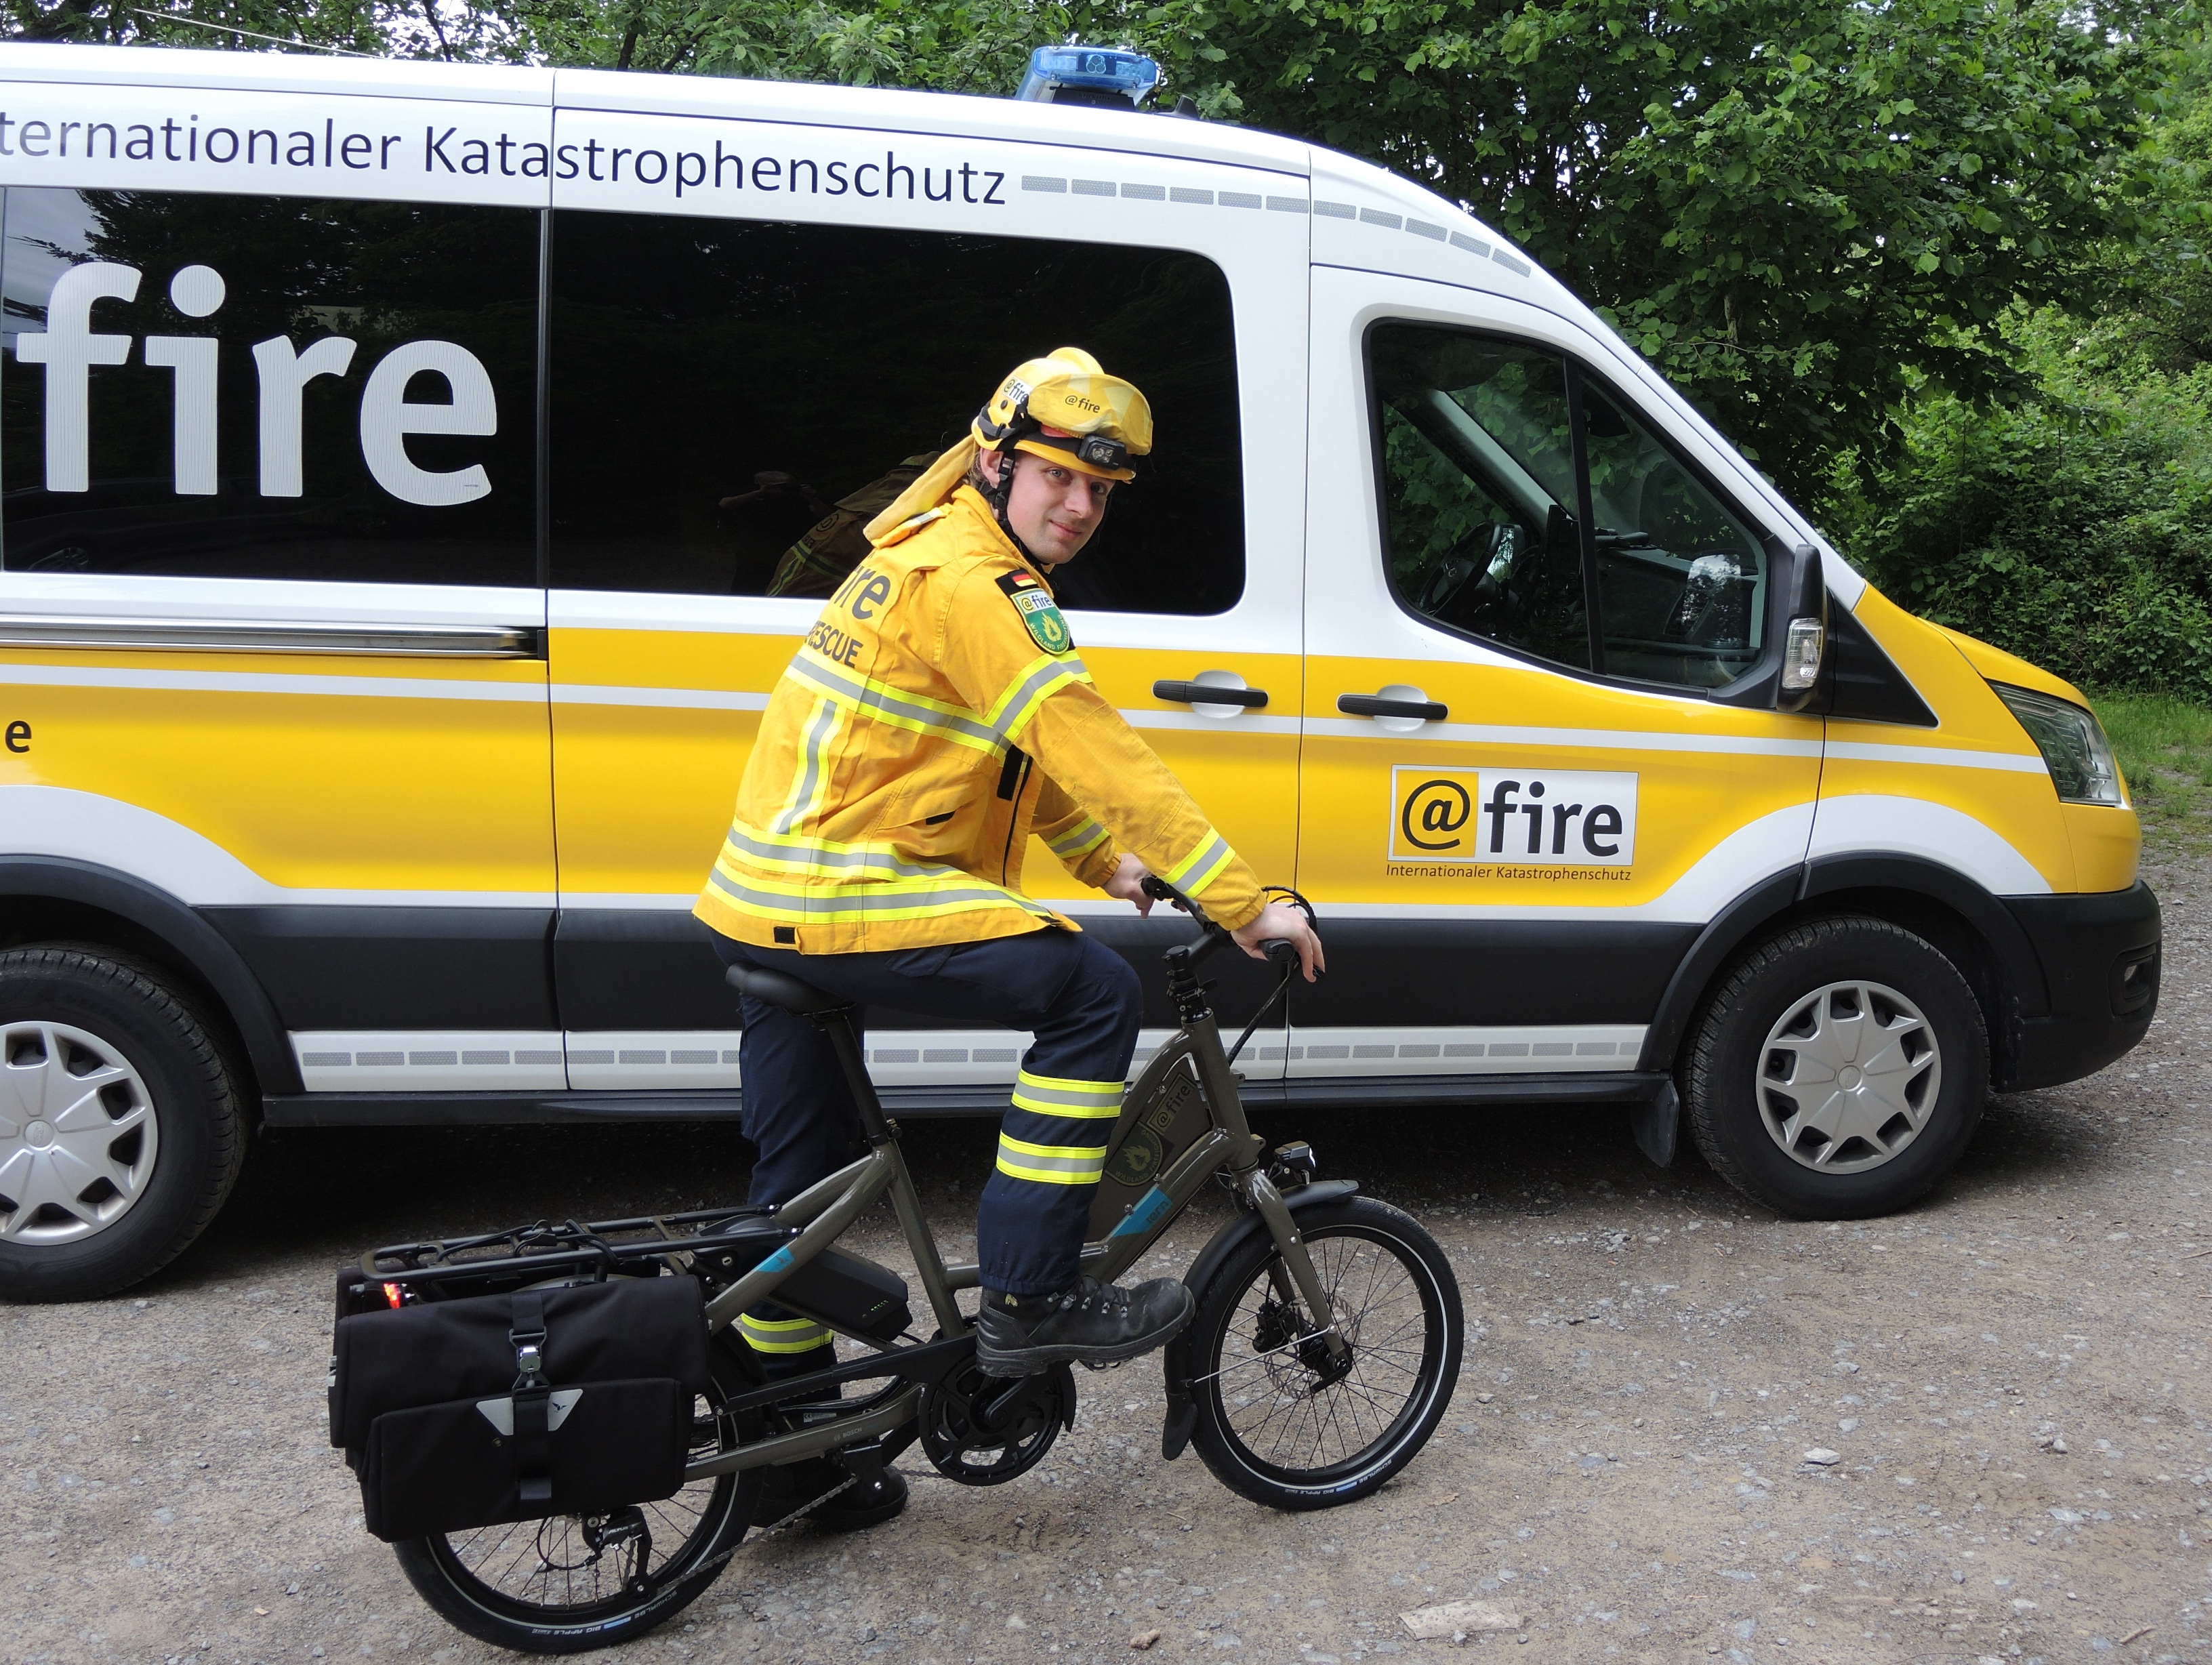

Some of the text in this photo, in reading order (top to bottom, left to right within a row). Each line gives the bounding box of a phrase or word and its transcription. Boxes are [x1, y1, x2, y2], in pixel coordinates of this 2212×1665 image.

[425, 125, 1006, 205] Katastrophenschutz
[16, 262, 497, 506] fire
[1065, 395, 1101, 413] @fire
[1021, 594, 1052, 611] @fire
[1030, 623, 1055, 650] WILDLAND
[1401, 779, 1622, 857] @fire
[1386, 864, 1631, 882] Internationaler Katastrophenschutz
[1156, 1084, 1191, 1128] @fire
[1359, 1460, 1391, 1483] SCHWALBE
[634, 1590, 677, 1619] SCHWALBE
[586, 1625, 602, 1633] BIG
